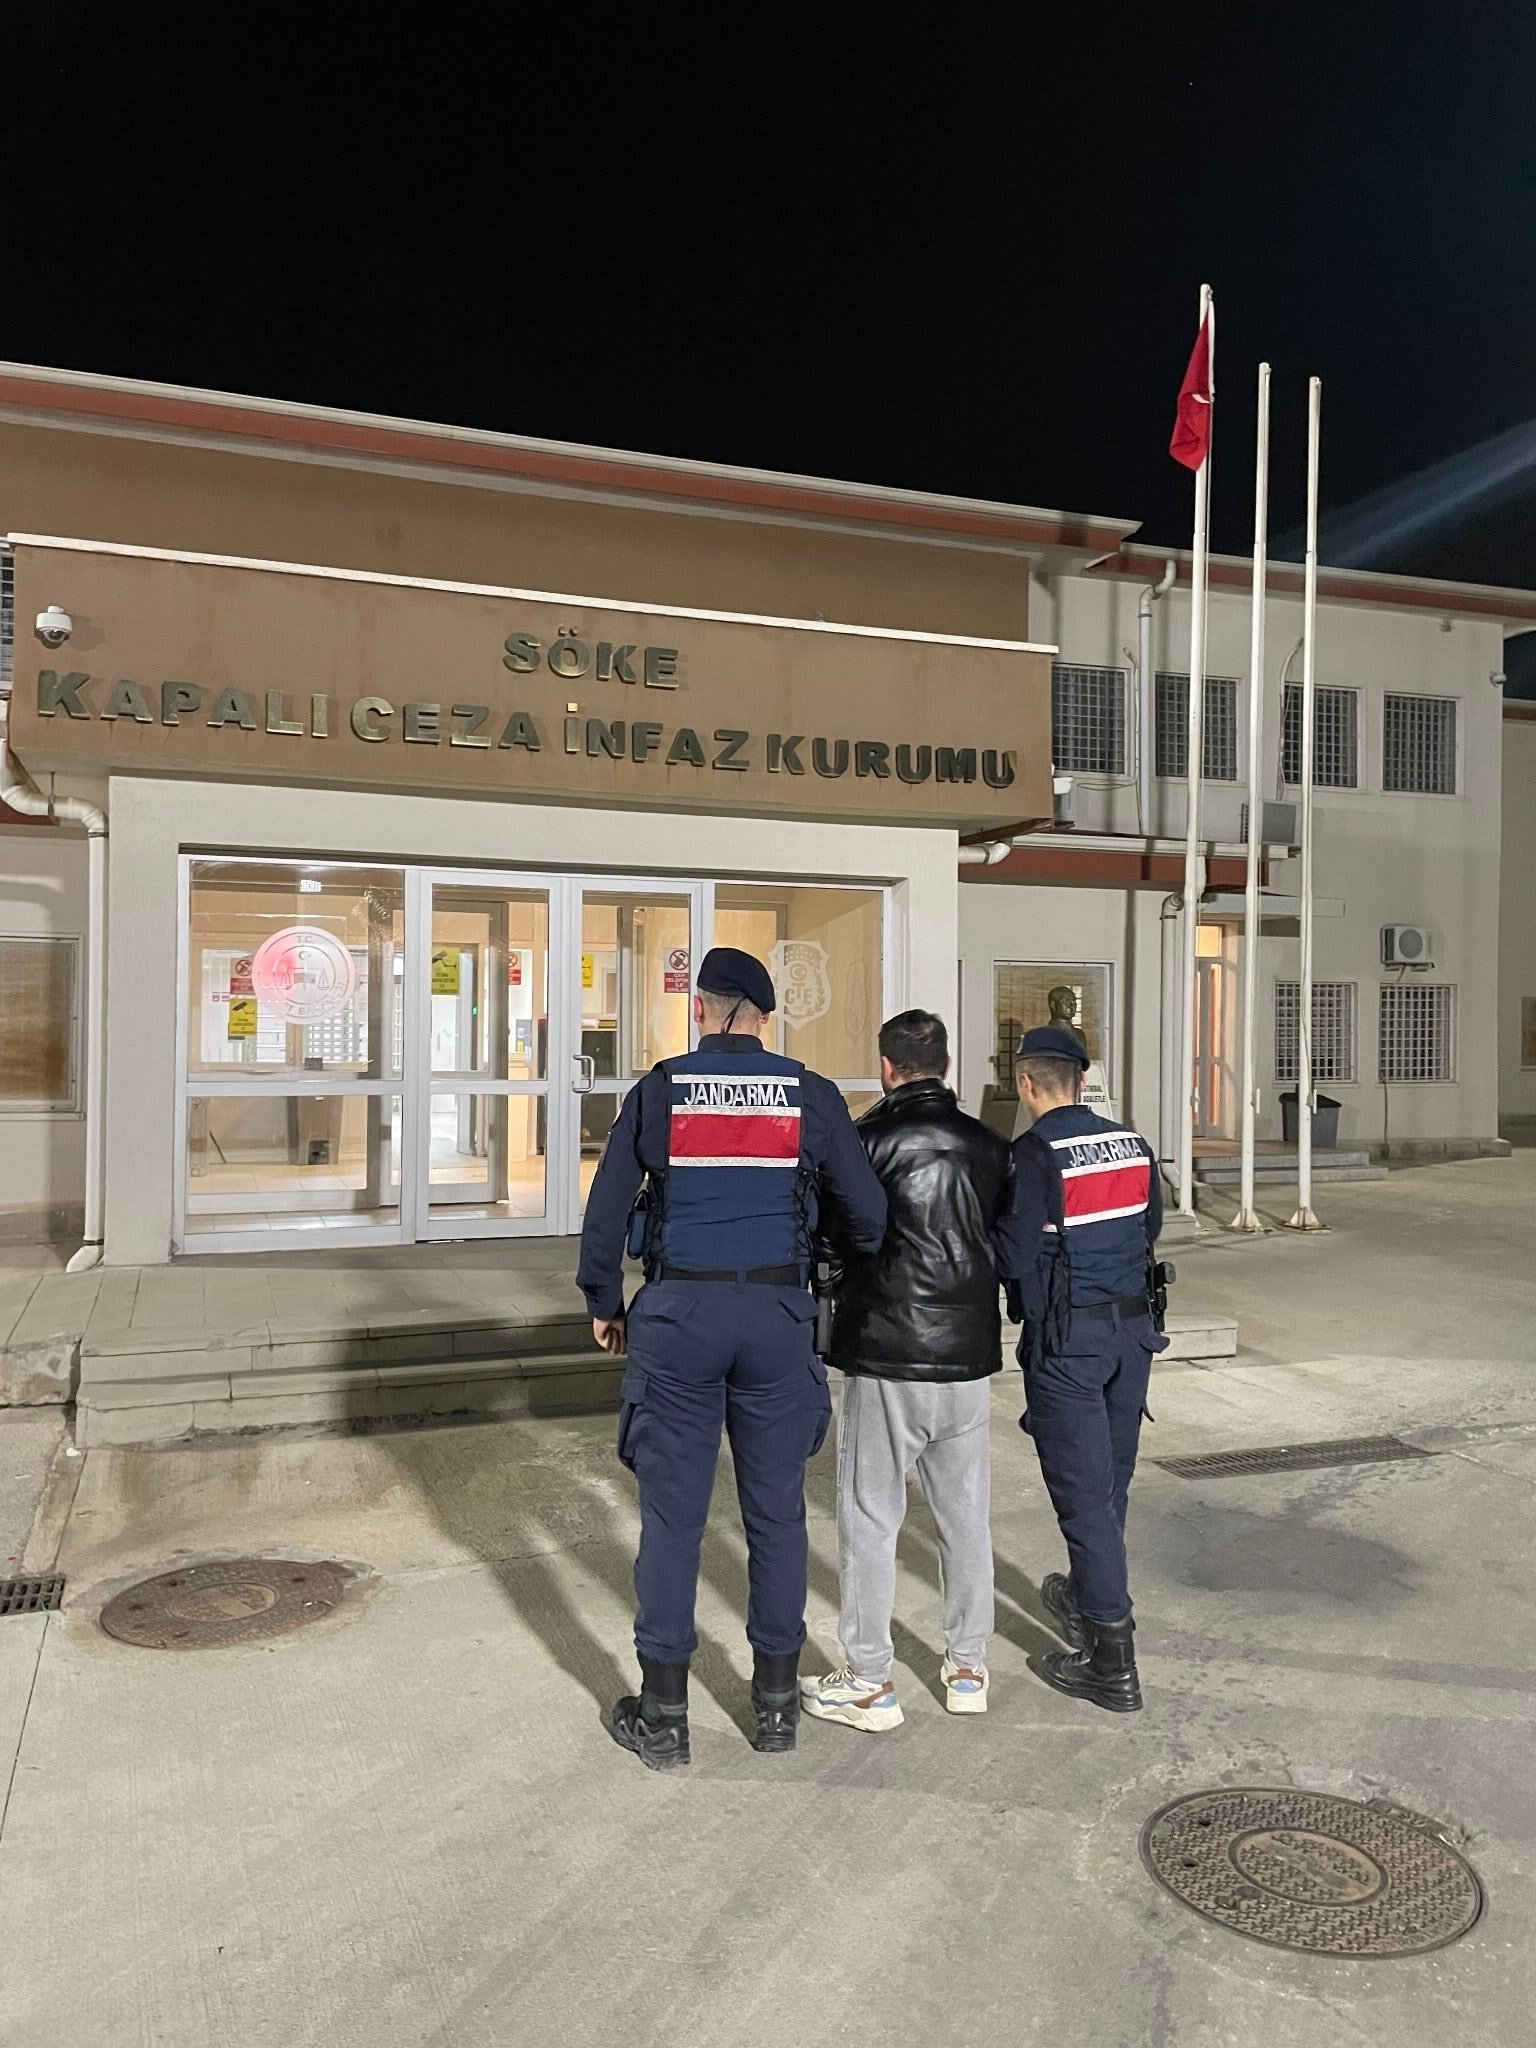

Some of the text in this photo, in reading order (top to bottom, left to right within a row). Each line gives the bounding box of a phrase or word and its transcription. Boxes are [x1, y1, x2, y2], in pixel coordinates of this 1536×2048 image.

[502, 623, 680, 689] SÖKE
[37, 668, 1018, 788] KAPALI CEZA İNFAZ KURUMU
[684, 1083, 789, 1107] JANDARMA
[1069, 1138, 1143, 1167] JANDARMA
